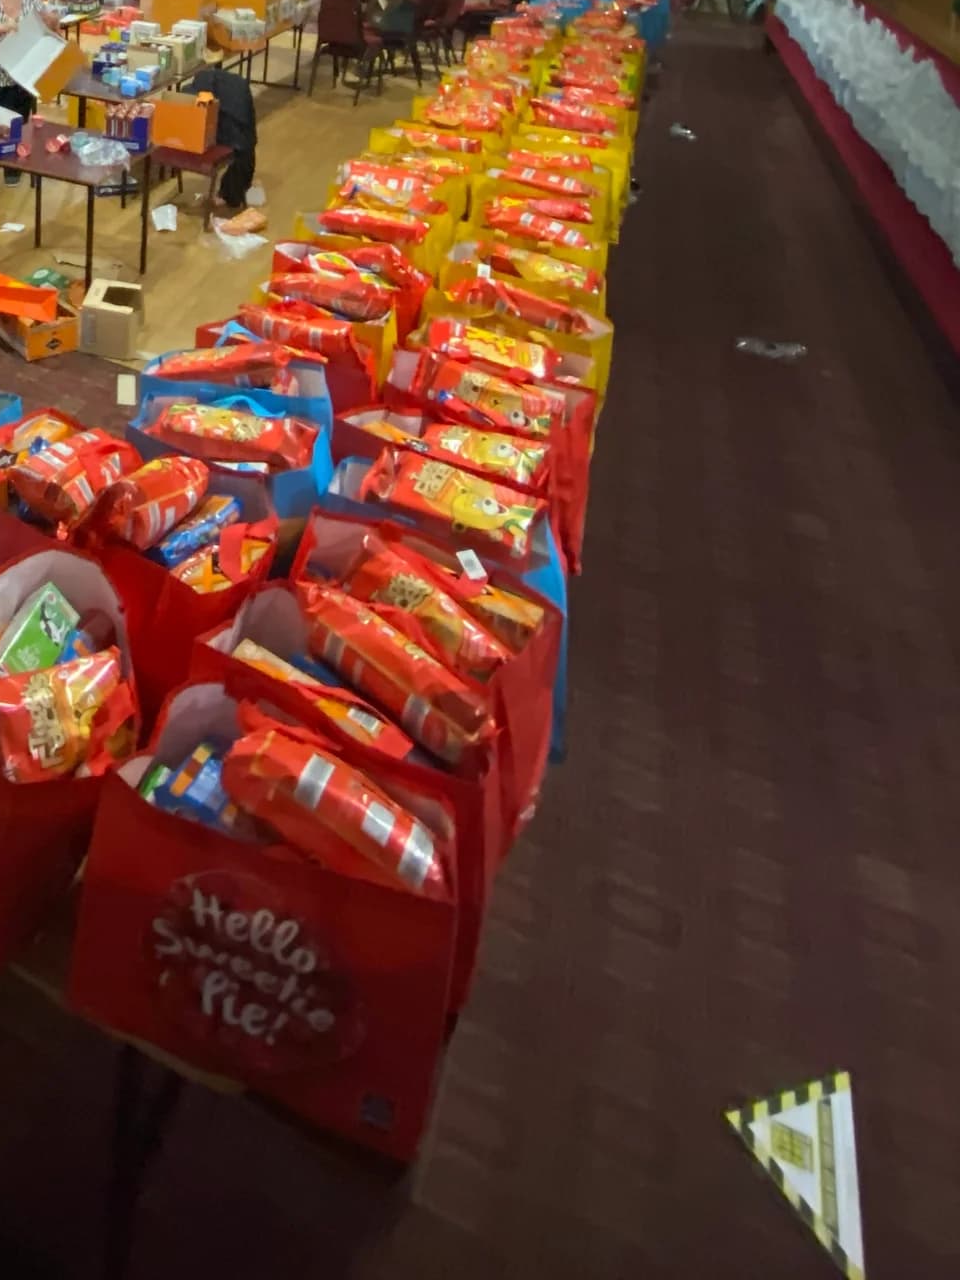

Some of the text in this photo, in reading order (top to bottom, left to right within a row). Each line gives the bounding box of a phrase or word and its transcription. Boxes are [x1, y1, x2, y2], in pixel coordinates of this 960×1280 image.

[189, 888, 317, 974] Hello
[152, 917, 337, 1033] Sweetie
[202, 971, 289, 1047] Pie!
